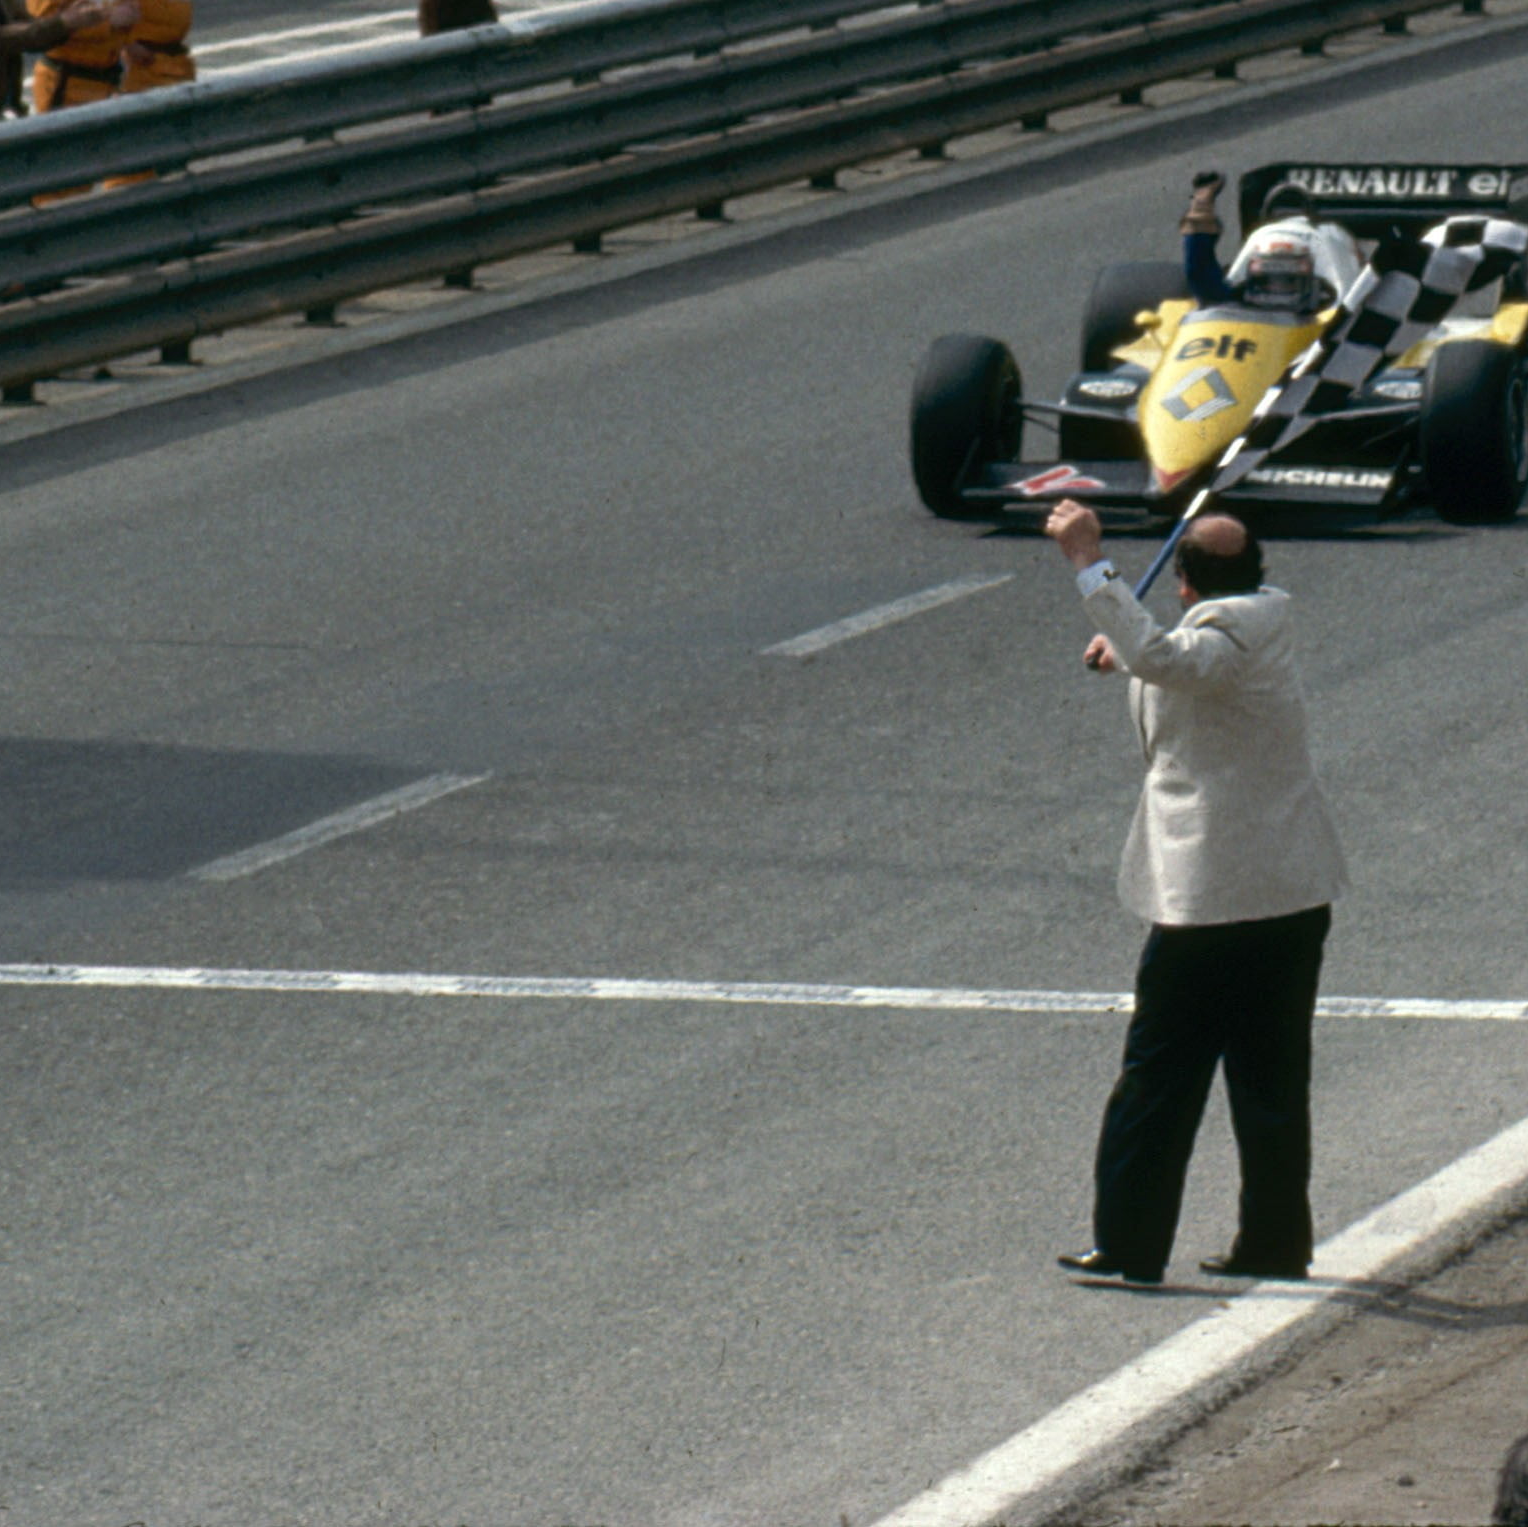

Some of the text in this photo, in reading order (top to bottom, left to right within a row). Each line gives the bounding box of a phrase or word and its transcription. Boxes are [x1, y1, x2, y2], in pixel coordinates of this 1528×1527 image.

[1285, 168, 1456, 197] RENAULT
[1175, 334, 1258, 363] elf
[1244, 468, 1395, 489] MICHELIN
